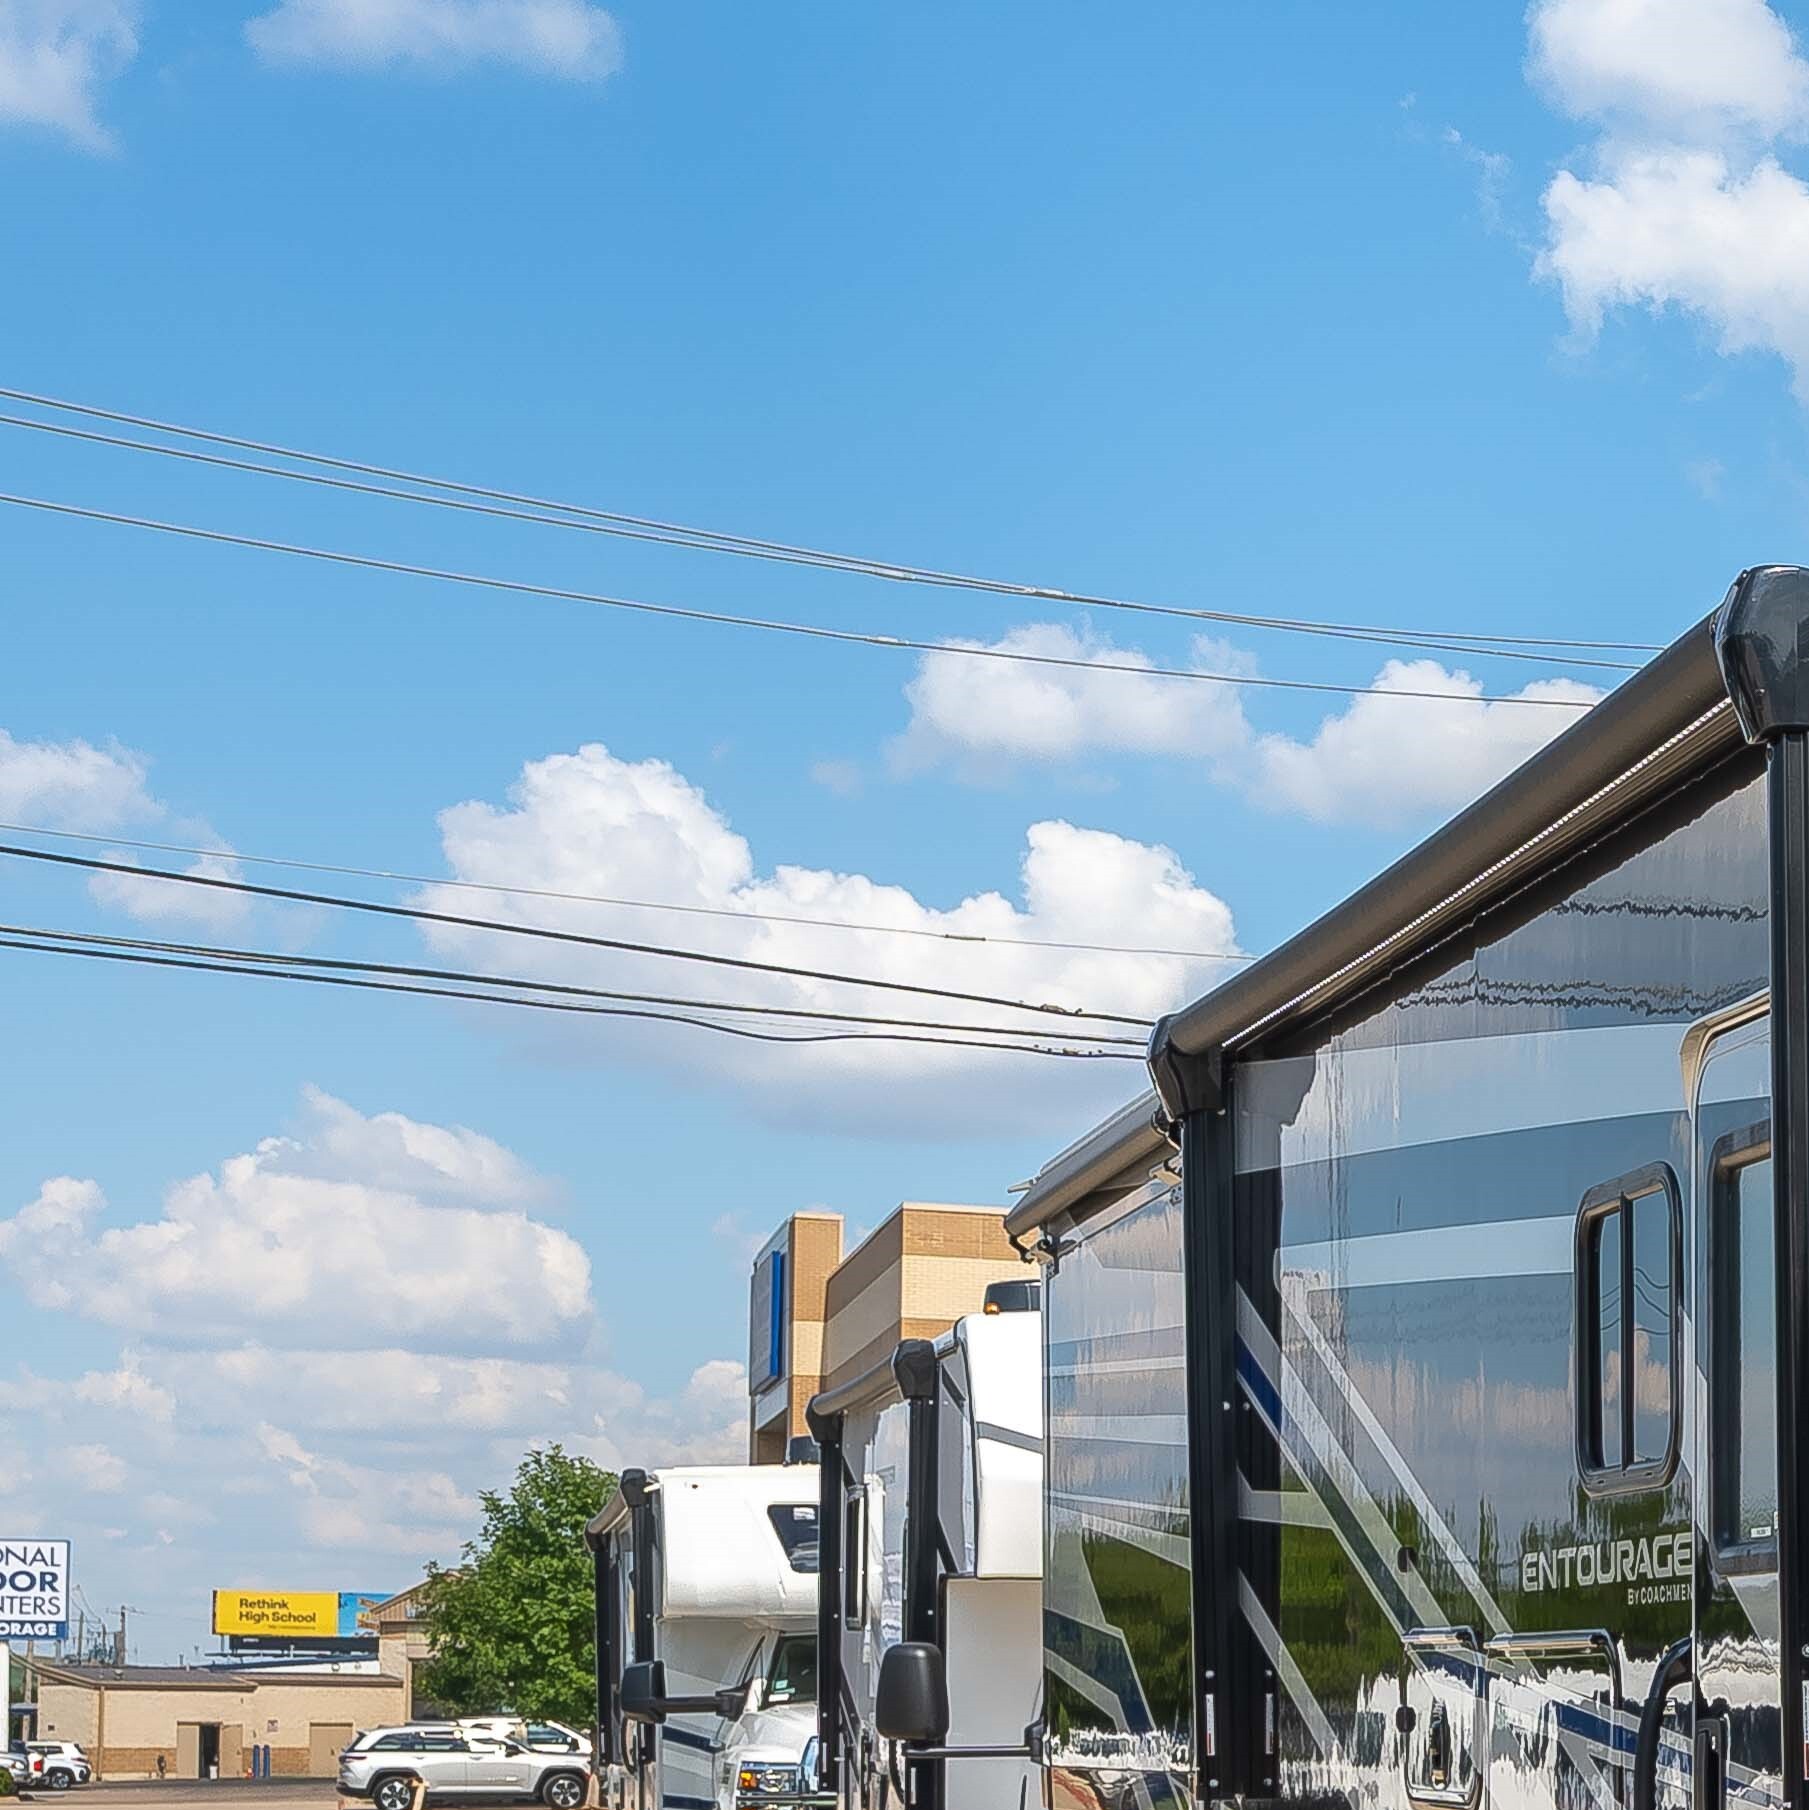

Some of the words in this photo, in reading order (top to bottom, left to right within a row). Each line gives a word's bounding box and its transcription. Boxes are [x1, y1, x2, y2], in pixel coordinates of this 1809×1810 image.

[0, 1545, 61, 1567] NAL
[1522, 1531, 1692, 1592] ENTOURAGE
[0, 1570, 60, 1592] OR
[239, 1598, 289, 1610] Rethink
[1628, 1588, 1639, 1605] BY
[1640, 1584, 1692, 1605] COACHMEN
[0, 1596, 60, 1615] TERS
[239, 1611, 270, 1624] High
[271, 1611, 316, 1623] School
